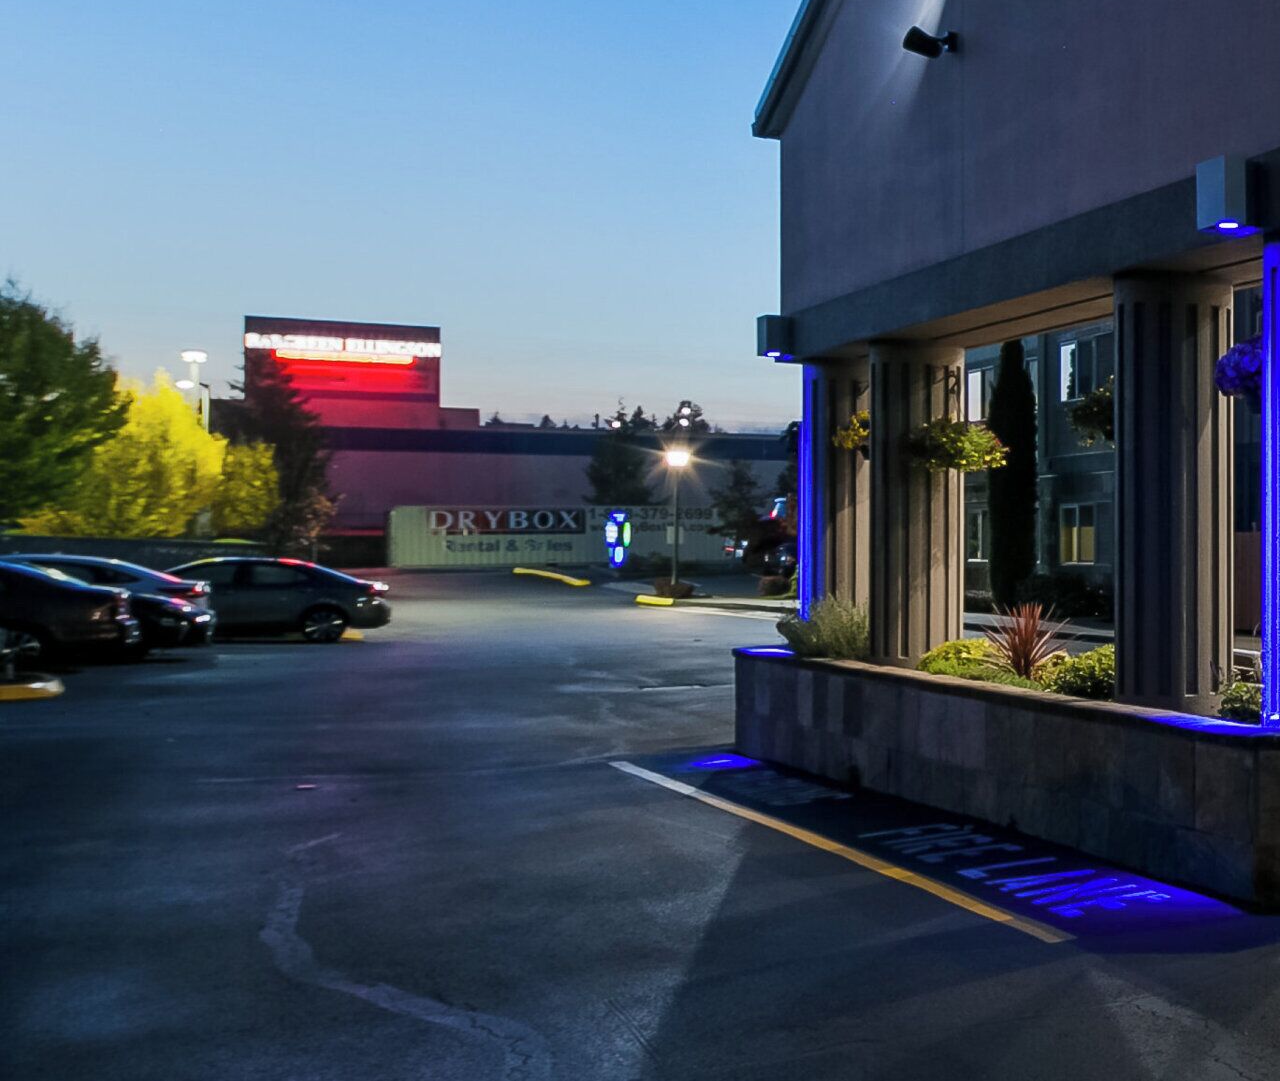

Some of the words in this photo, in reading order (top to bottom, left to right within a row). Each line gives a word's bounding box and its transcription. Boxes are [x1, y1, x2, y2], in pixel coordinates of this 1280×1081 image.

[429, 510, 578, 529] DRYBOX
[505, 539, 519, 552] &
[858, 822, 1024, 864] FIRE
[955, 856, 1172, 918] LANE
